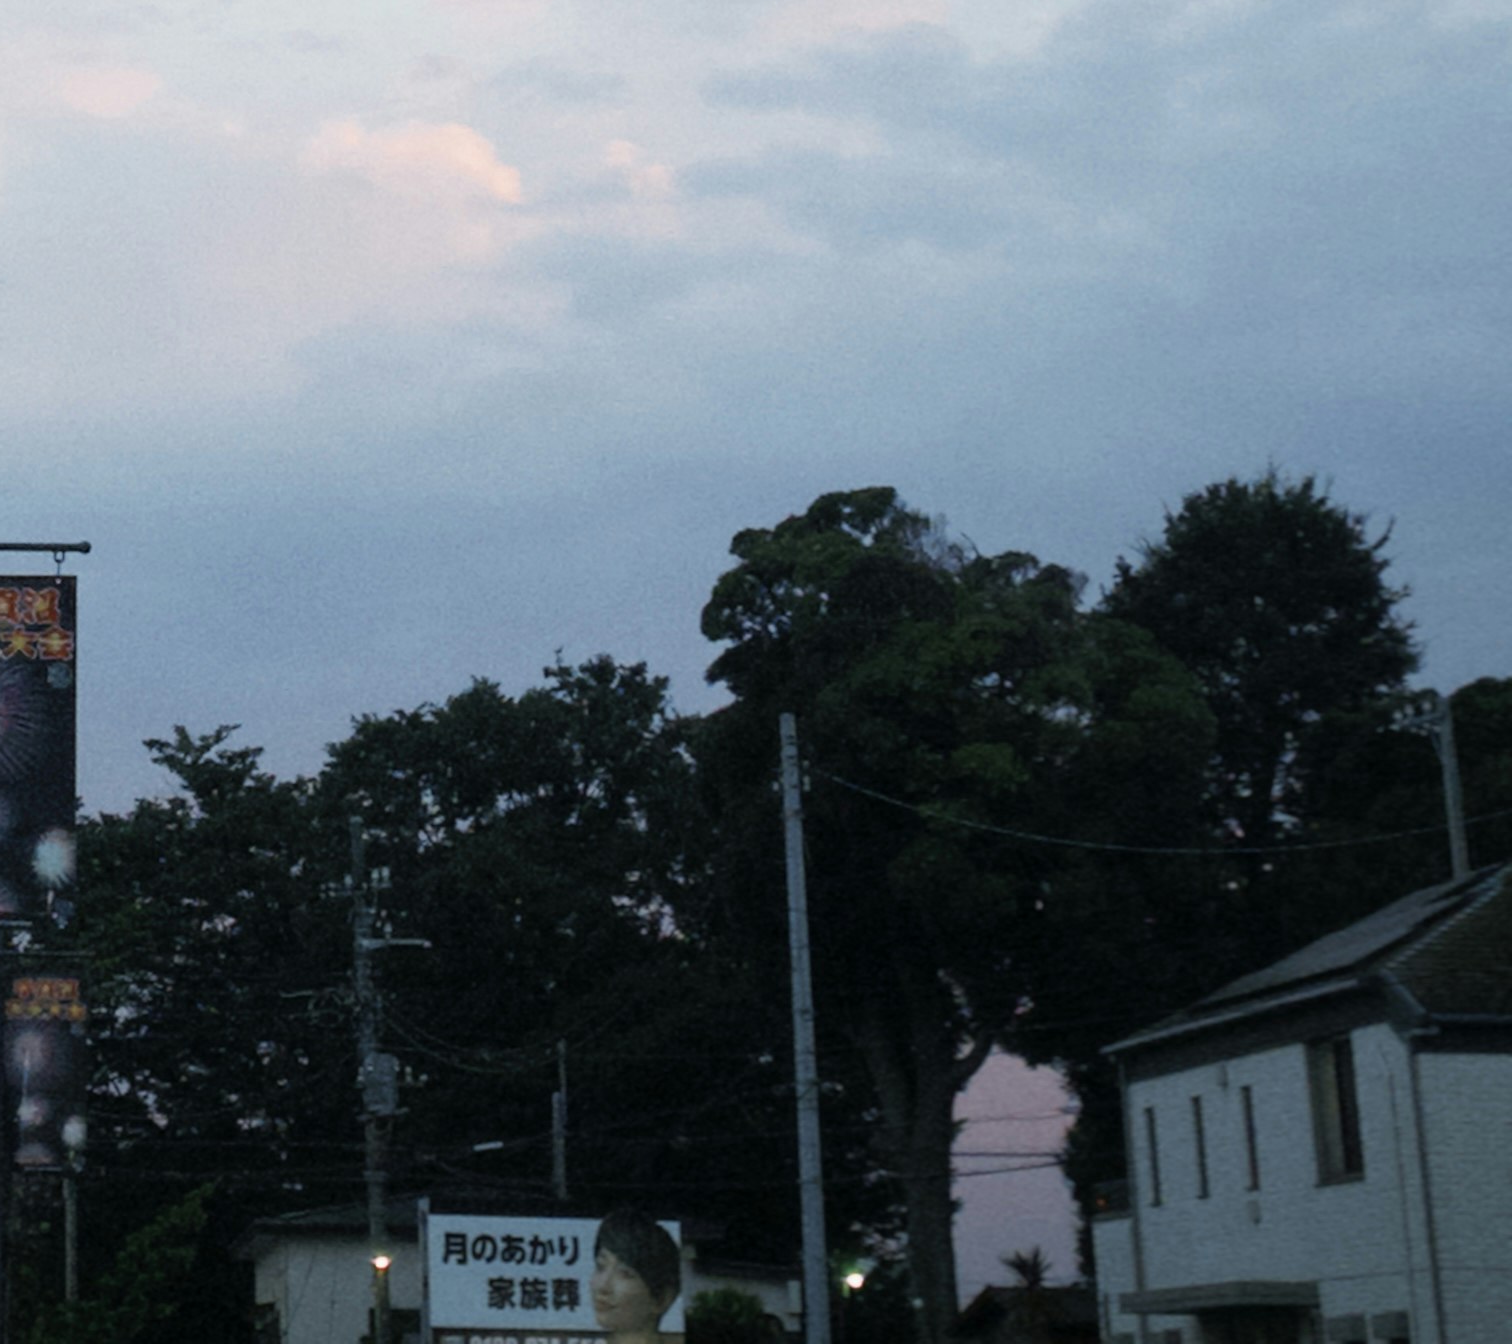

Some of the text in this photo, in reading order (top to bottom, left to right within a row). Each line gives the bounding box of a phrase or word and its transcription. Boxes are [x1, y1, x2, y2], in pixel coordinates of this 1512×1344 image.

[442, 1233, 579, 1266] 月のあかり
[488, 1276, 580, 1312] 家族葬
